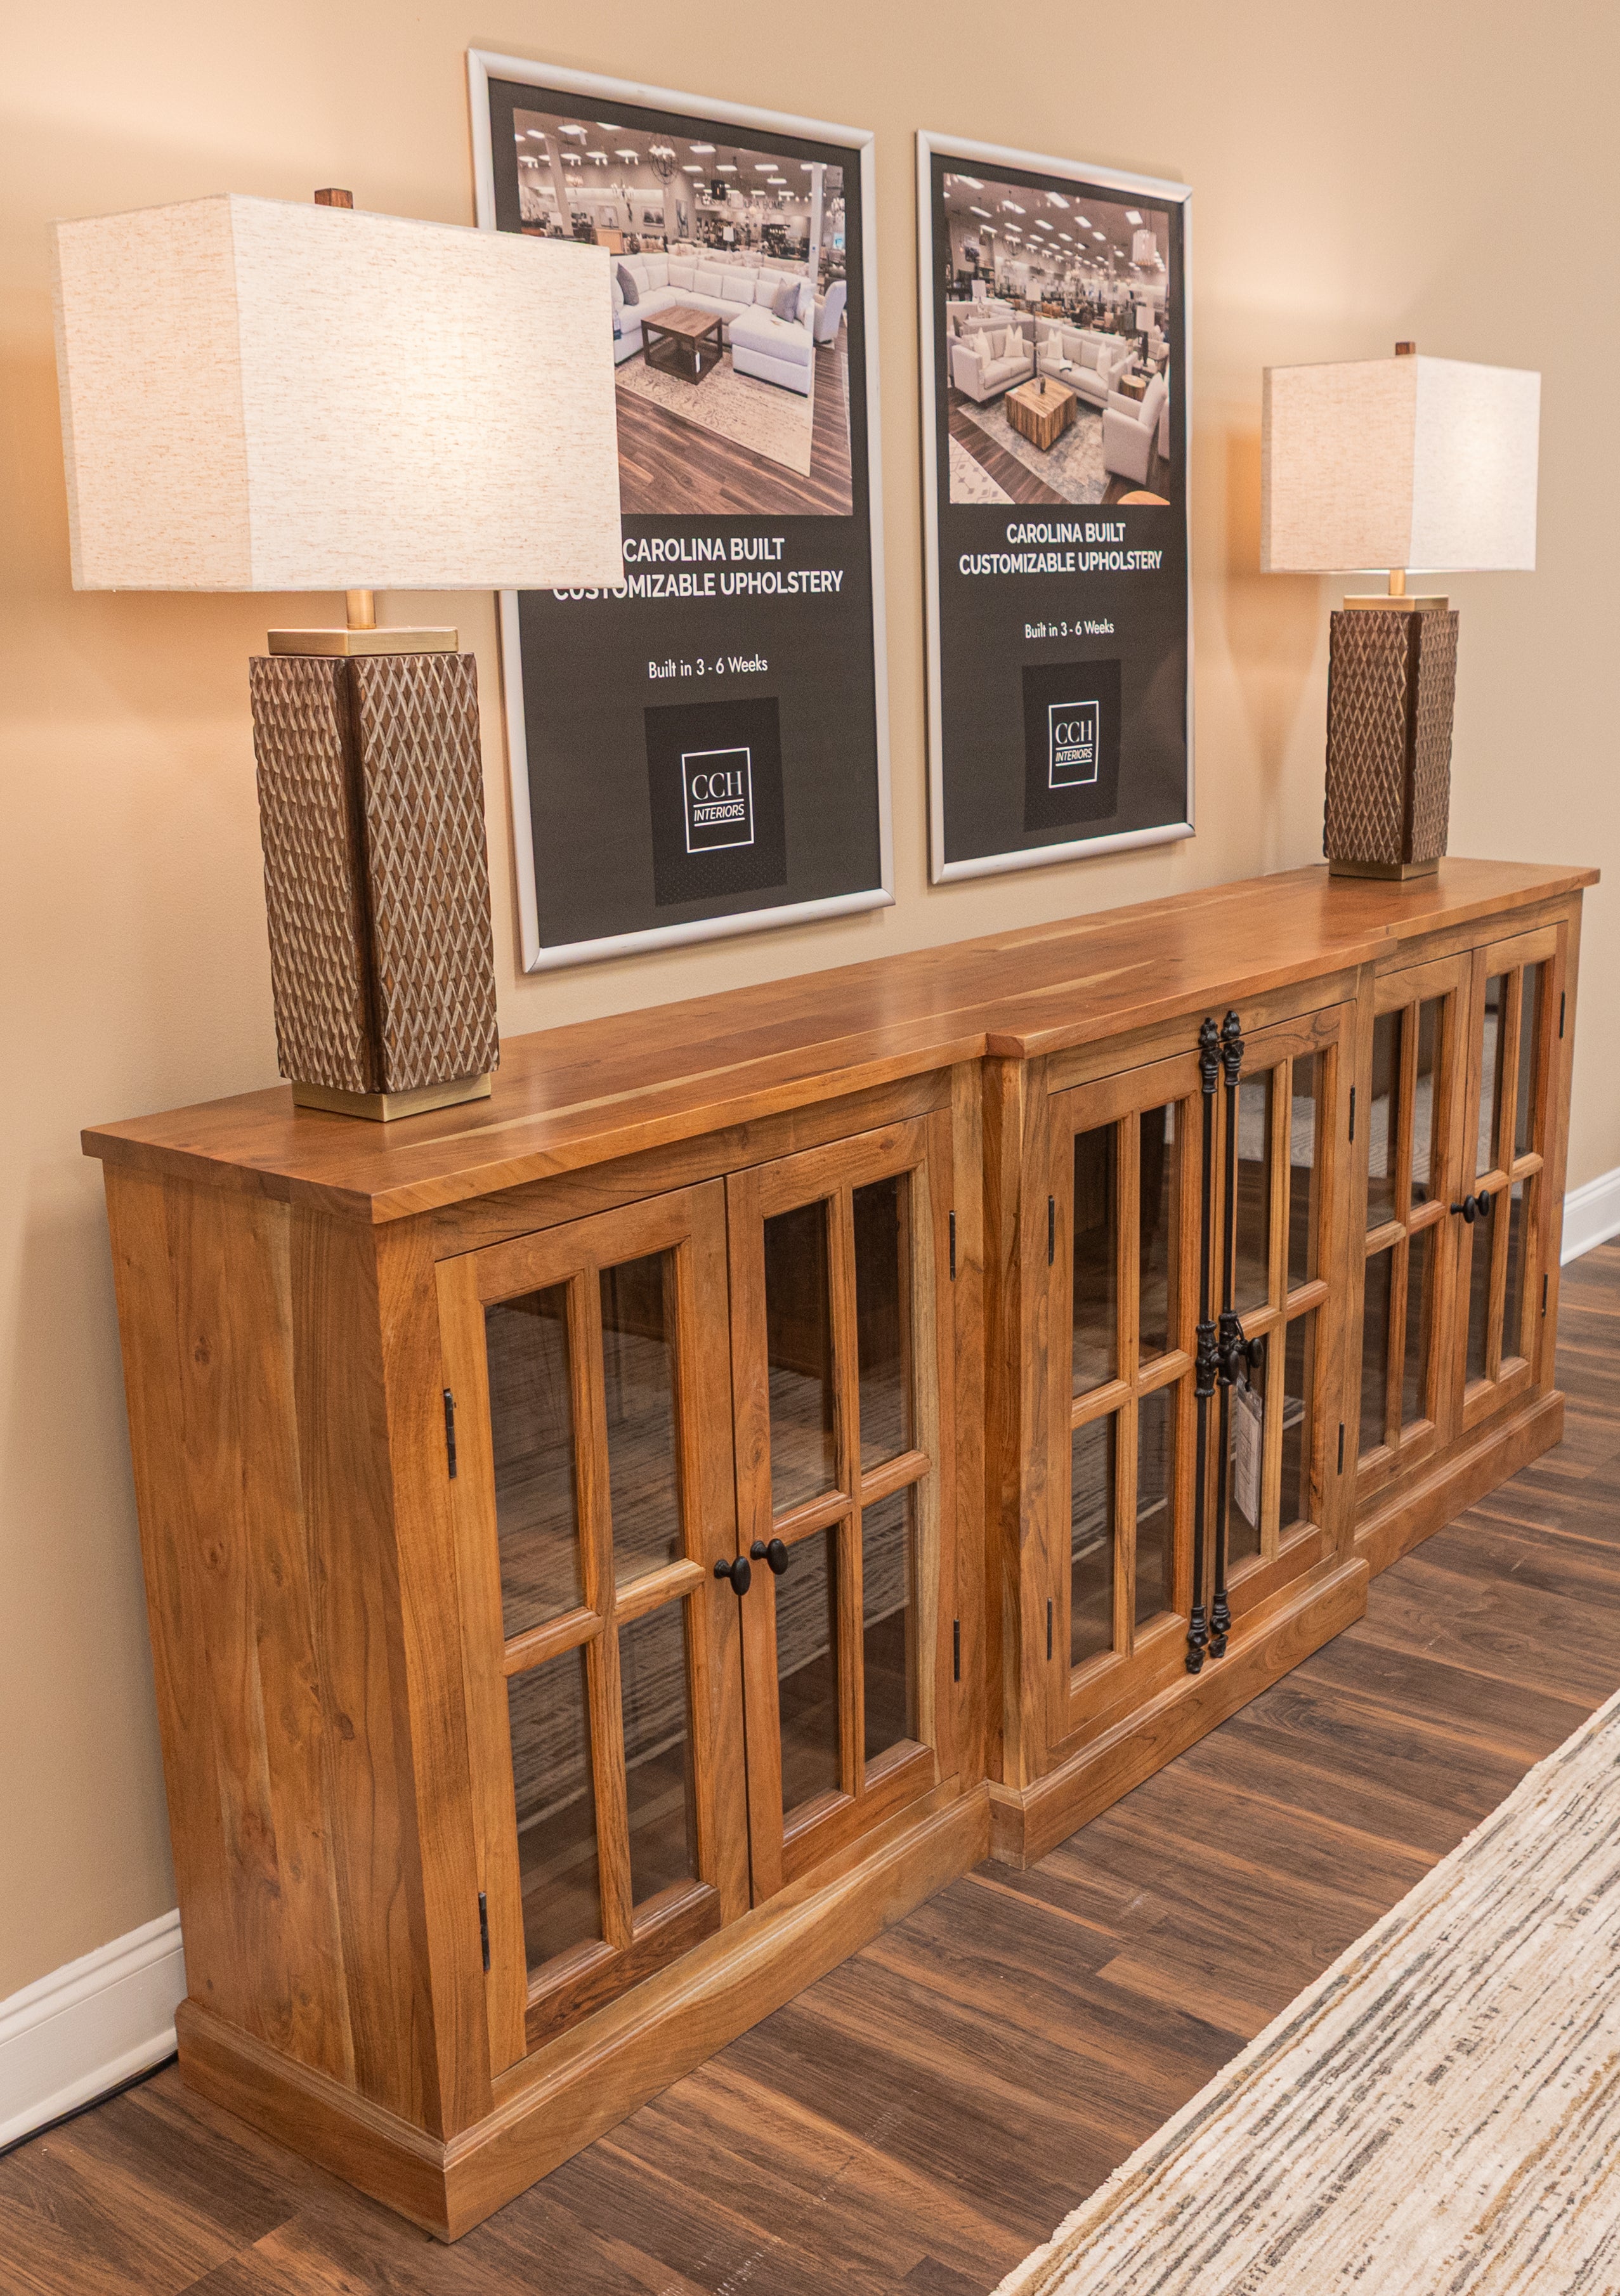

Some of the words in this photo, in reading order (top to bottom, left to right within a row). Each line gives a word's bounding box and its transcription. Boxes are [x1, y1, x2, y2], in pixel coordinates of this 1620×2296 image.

[1006, 523, 1083, 544] CAROLINA
[1085, 523, 1126, 542] BUILT
[623, 538, 727, 563] CAROLINA
[730, 537, 785, 561] BUILT
[959, 552, 1076, 575] CUSTOMIZABLE
[1078, 551, 1163, 571] UPHOLSTERY
[720, 570, 844, 596] UPHOLSTERY
[1024, 622, 1047, 639] Built
[1048, 622, 1058, 637] in
[1061, 622, 1068, 637] 3
[1075, 621, 1082, 636] 6
[1083, 618, 1114, 634] Weeks
[648, 658, 677, 679] Built
[680, 660, 692, 677] in
[696, 658, 705, 675] 3
[715, 657, 724, 674] 6
[727, 653, 768, 673] Weeks
[1055, 720, 1093, 745] CCH
[1055, 747, 1093, 762] INTERIORS
[691, 771, 743, 800] CCH
[693, 804, 745, 822] INTERIORS
